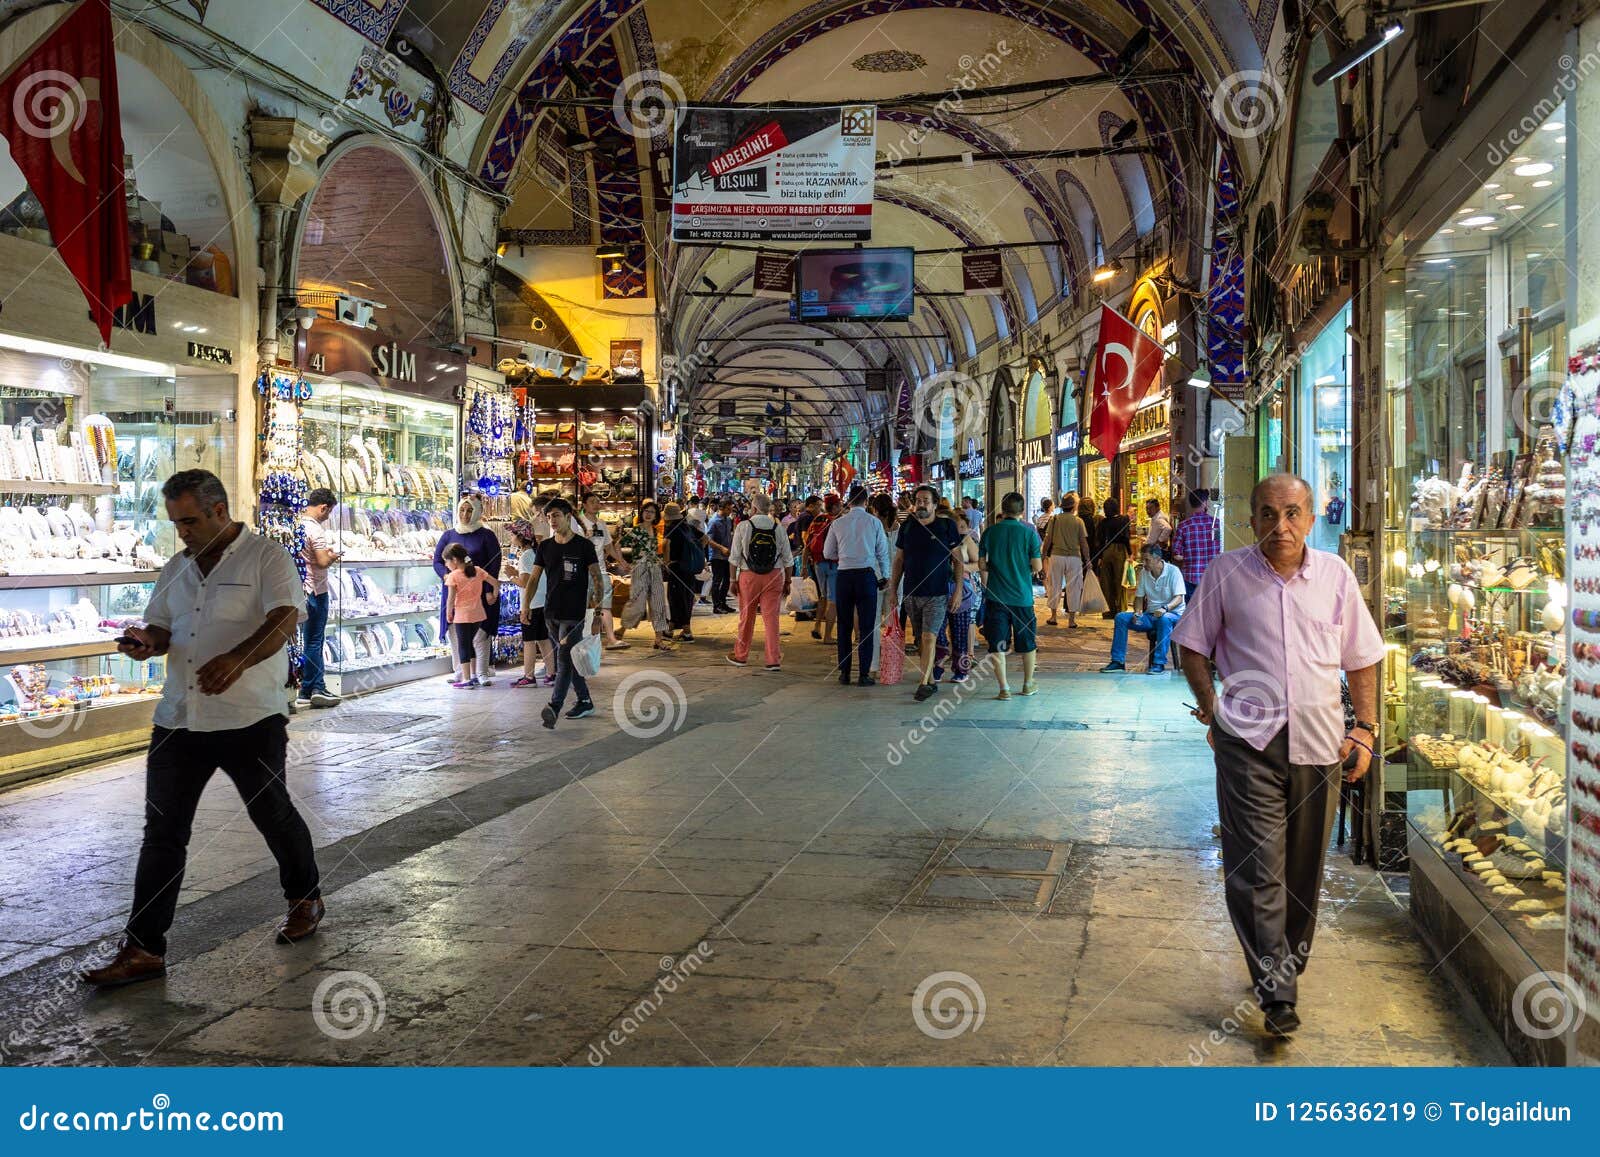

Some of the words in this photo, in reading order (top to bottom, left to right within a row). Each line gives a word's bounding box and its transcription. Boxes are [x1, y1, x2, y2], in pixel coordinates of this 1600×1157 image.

[711, 133, 772, 174] HABERİNİZ
[720, 174, 758, 189] OLSUN!
[806, 178, 858, 186] KAZANMAK
[781, 190, 796, 198] bizi
[799, 190, 822, 200] takip
[824, 189, 846, 198] edin!
[691, 206, 732, 214] ÇARŞIMIZDA
[757, 205, 787, 213] OLUYOR?
[790, 205, 827, 214] HABERİNİZ
[830, 205, 855, 213] OLSUN!
[313, 353, 325, 373] 41
[376, 342, 416, 383] SİM
